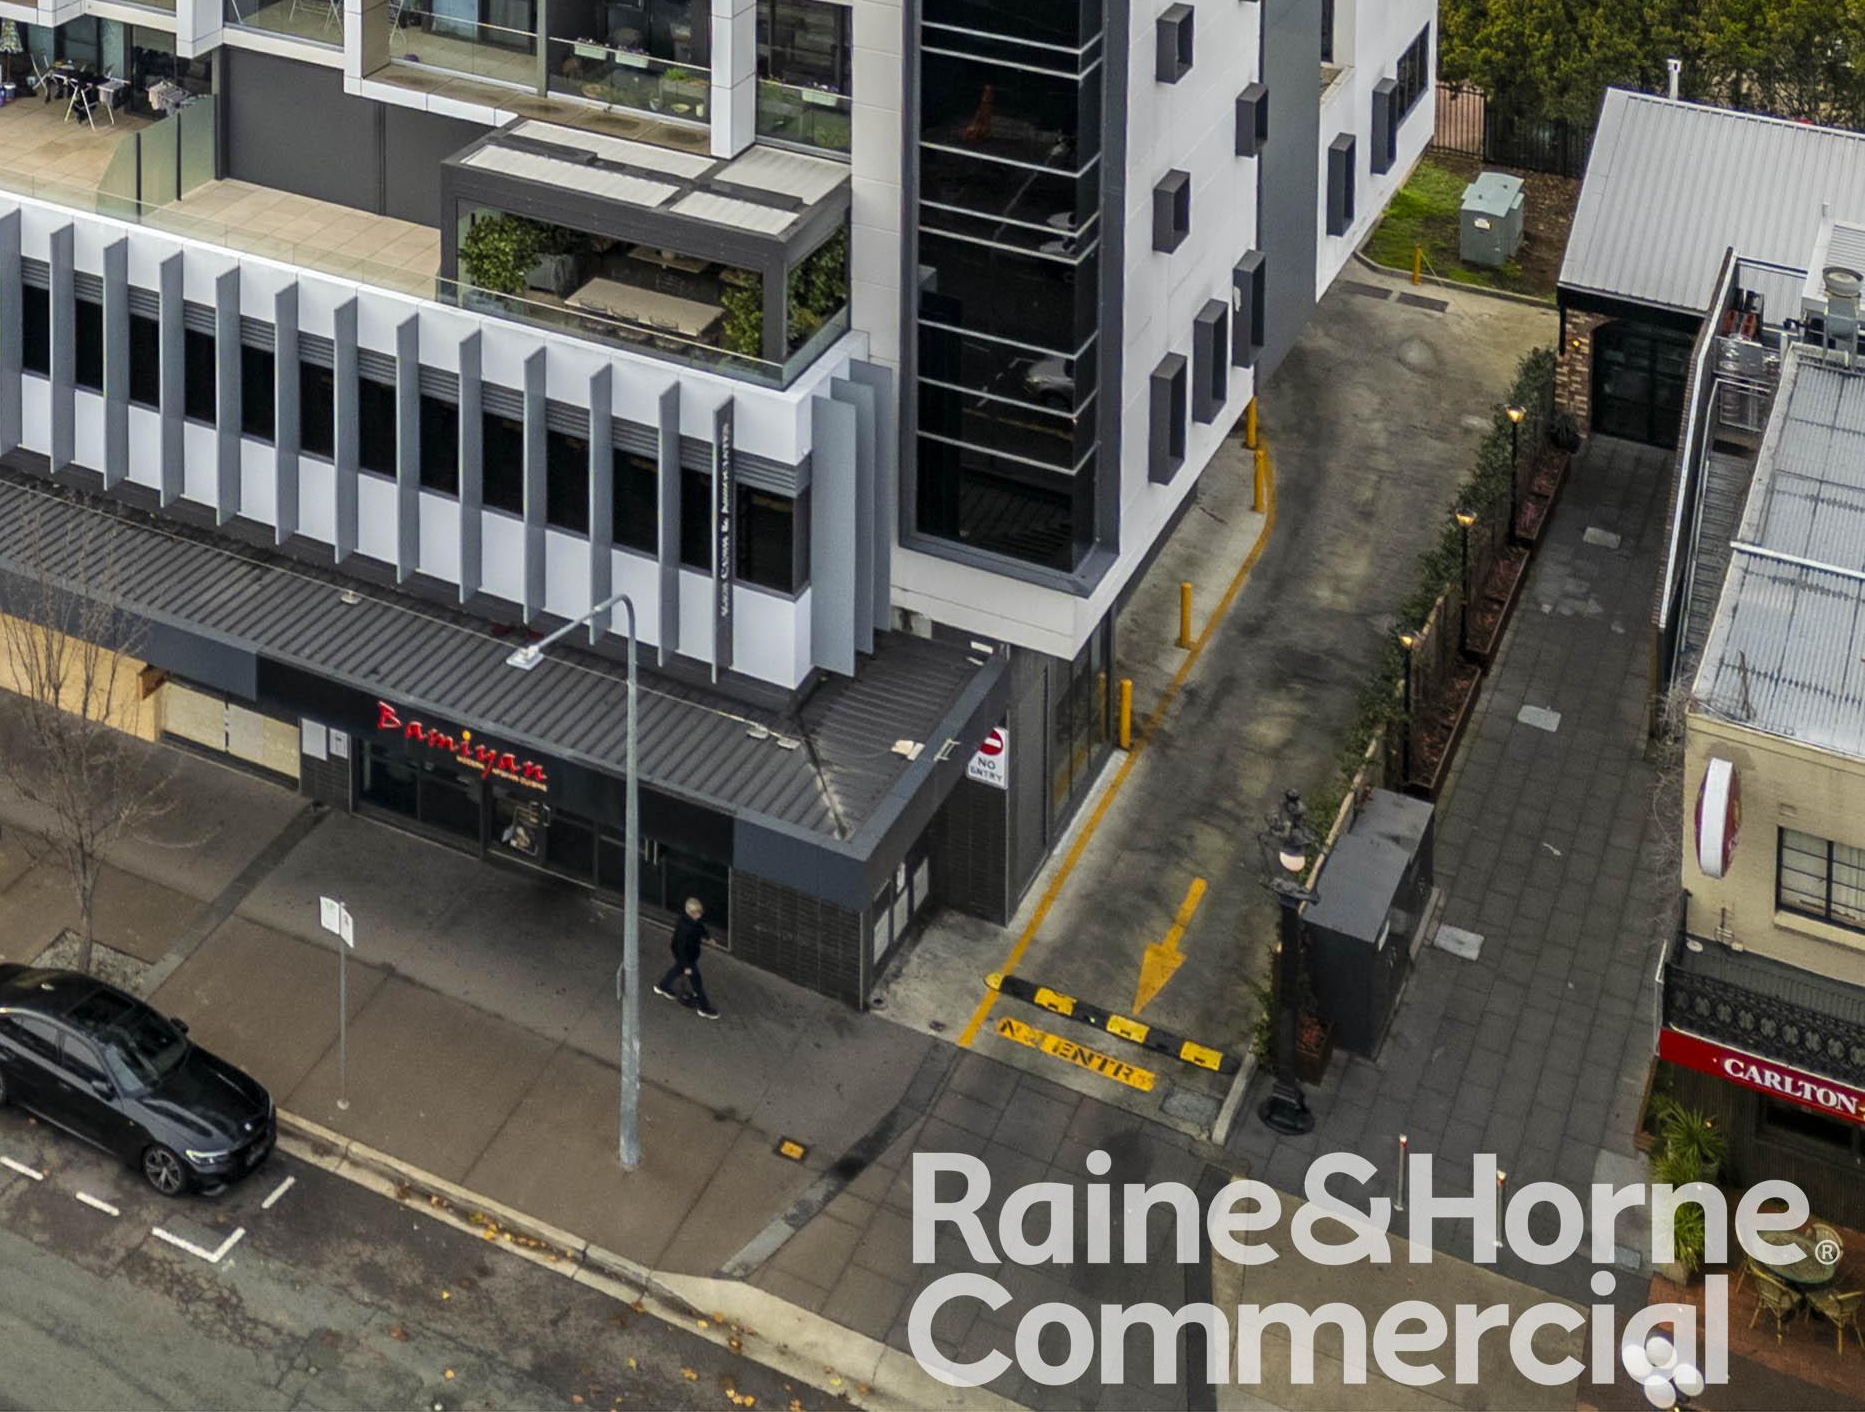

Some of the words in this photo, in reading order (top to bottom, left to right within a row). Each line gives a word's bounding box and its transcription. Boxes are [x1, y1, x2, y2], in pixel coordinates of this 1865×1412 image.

[377, 700, 548, 780] Bamiyan
[977, 757, 996, 770] NO
[970, 765, 1003, 782] ENTRY
[1051, 1040, 1153, 1087] ENTR
[1723, 1057, 1859, 1116] CARLTON
